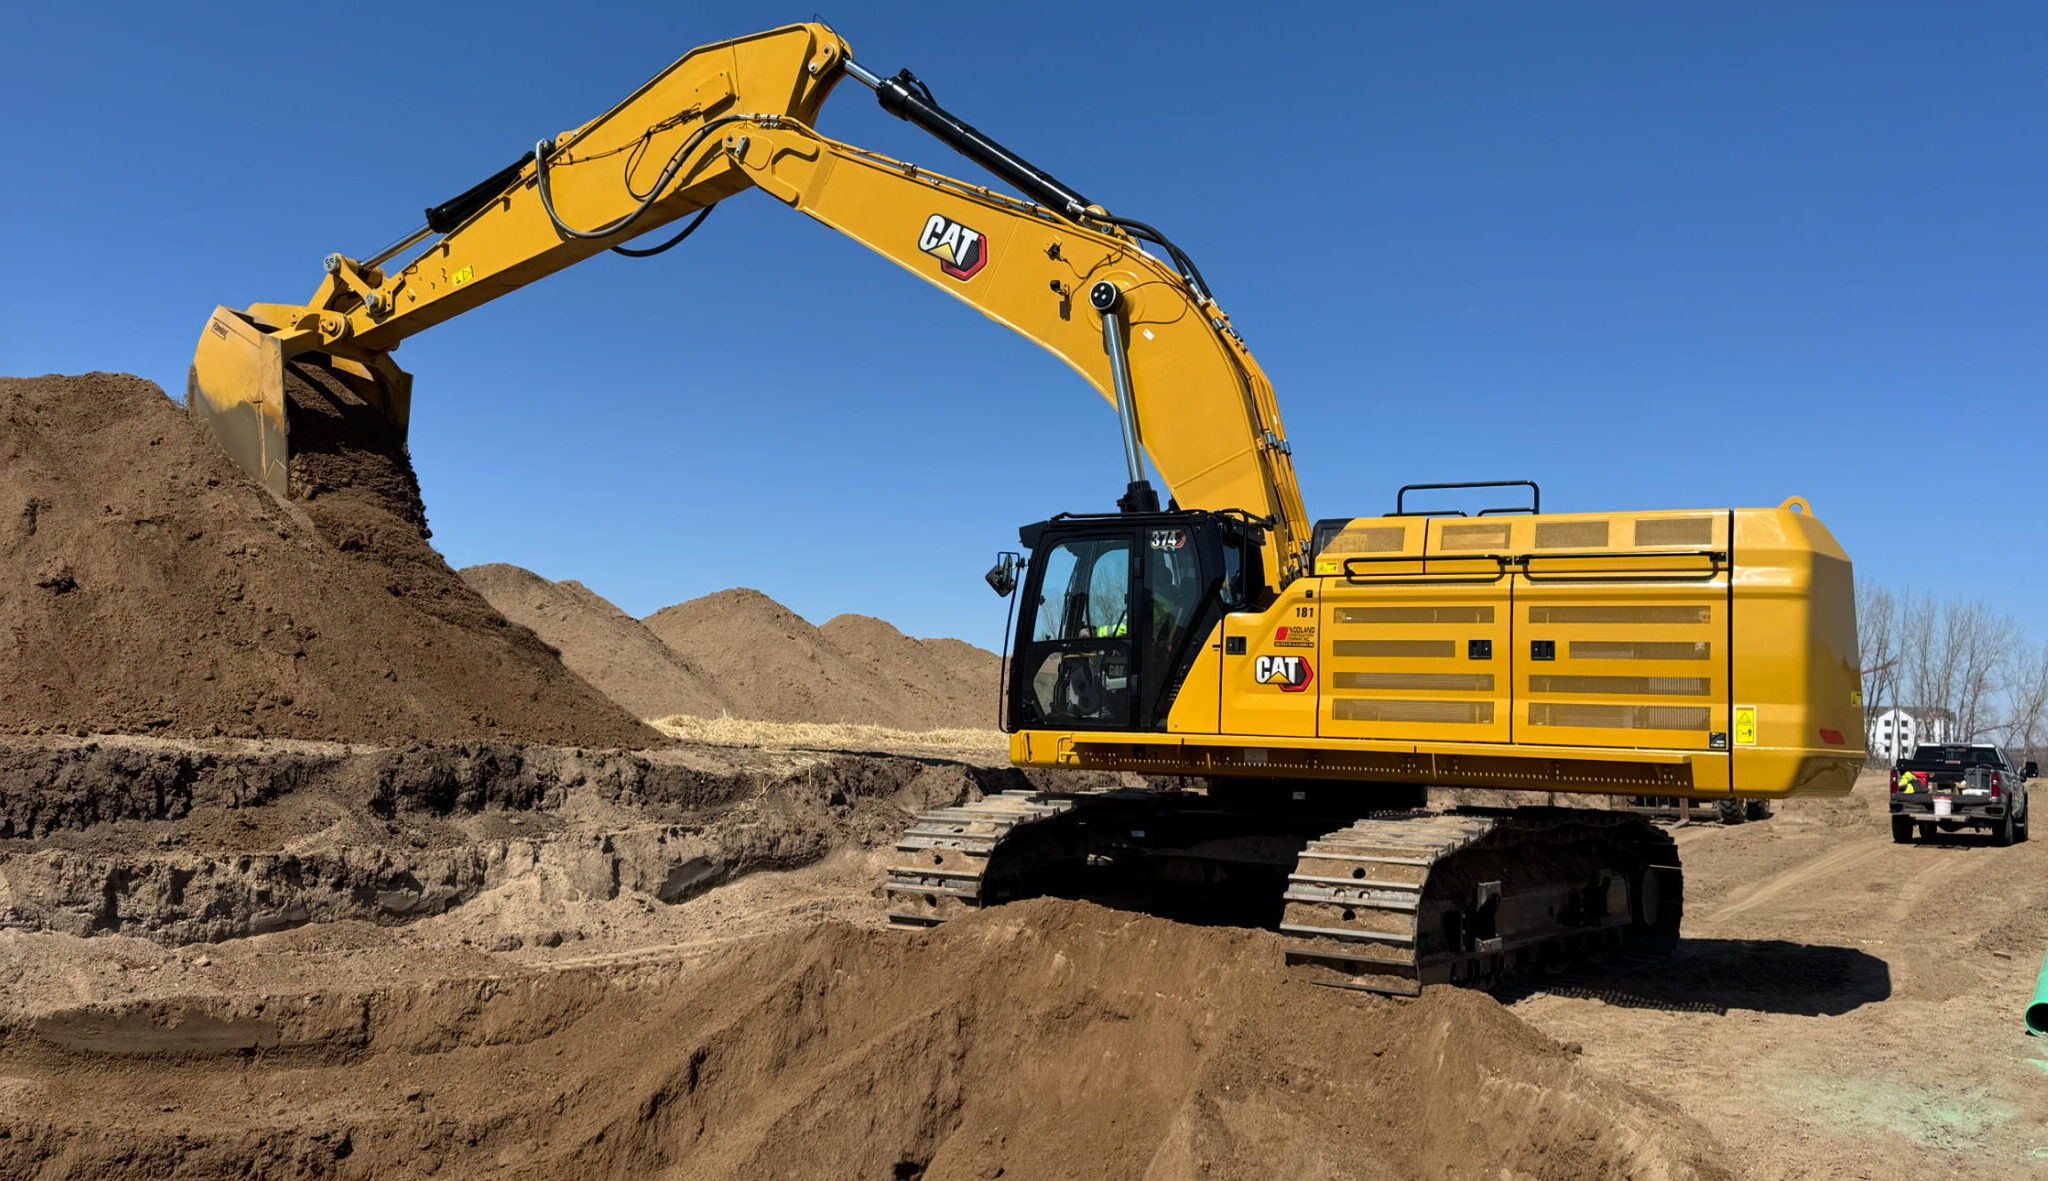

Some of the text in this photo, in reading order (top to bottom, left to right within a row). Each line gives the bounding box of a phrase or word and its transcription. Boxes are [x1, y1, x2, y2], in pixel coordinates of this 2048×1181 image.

[919, 214, 980, 266] CAT
[1151, 530, 1177, 547] 374
[1296, 607, 1314, 618] 181
[1256, 656, 1299, 684] CAT
